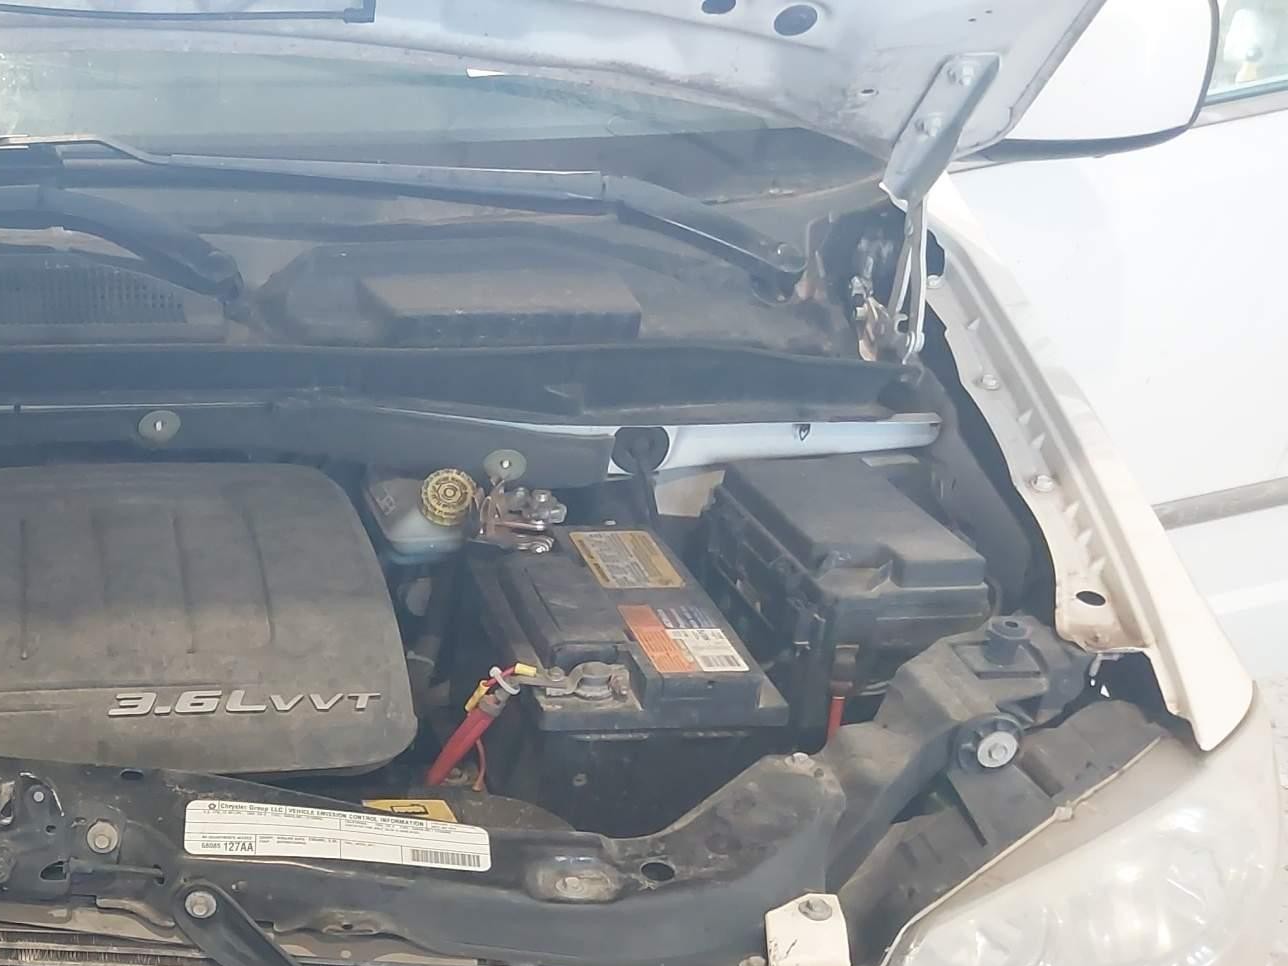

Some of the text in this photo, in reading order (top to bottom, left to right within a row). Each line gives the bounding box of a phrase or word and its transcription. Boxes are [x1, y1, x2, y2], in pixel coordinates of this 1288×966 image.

[220, 803, 247, 811] Chrysler
[316, 810, 347, 818] EMISSION
[349, 814, 378, 822] CONTROL
[380, 817, 424, 827] INFORMATION
[224, 842, 254, 852] 127AA
